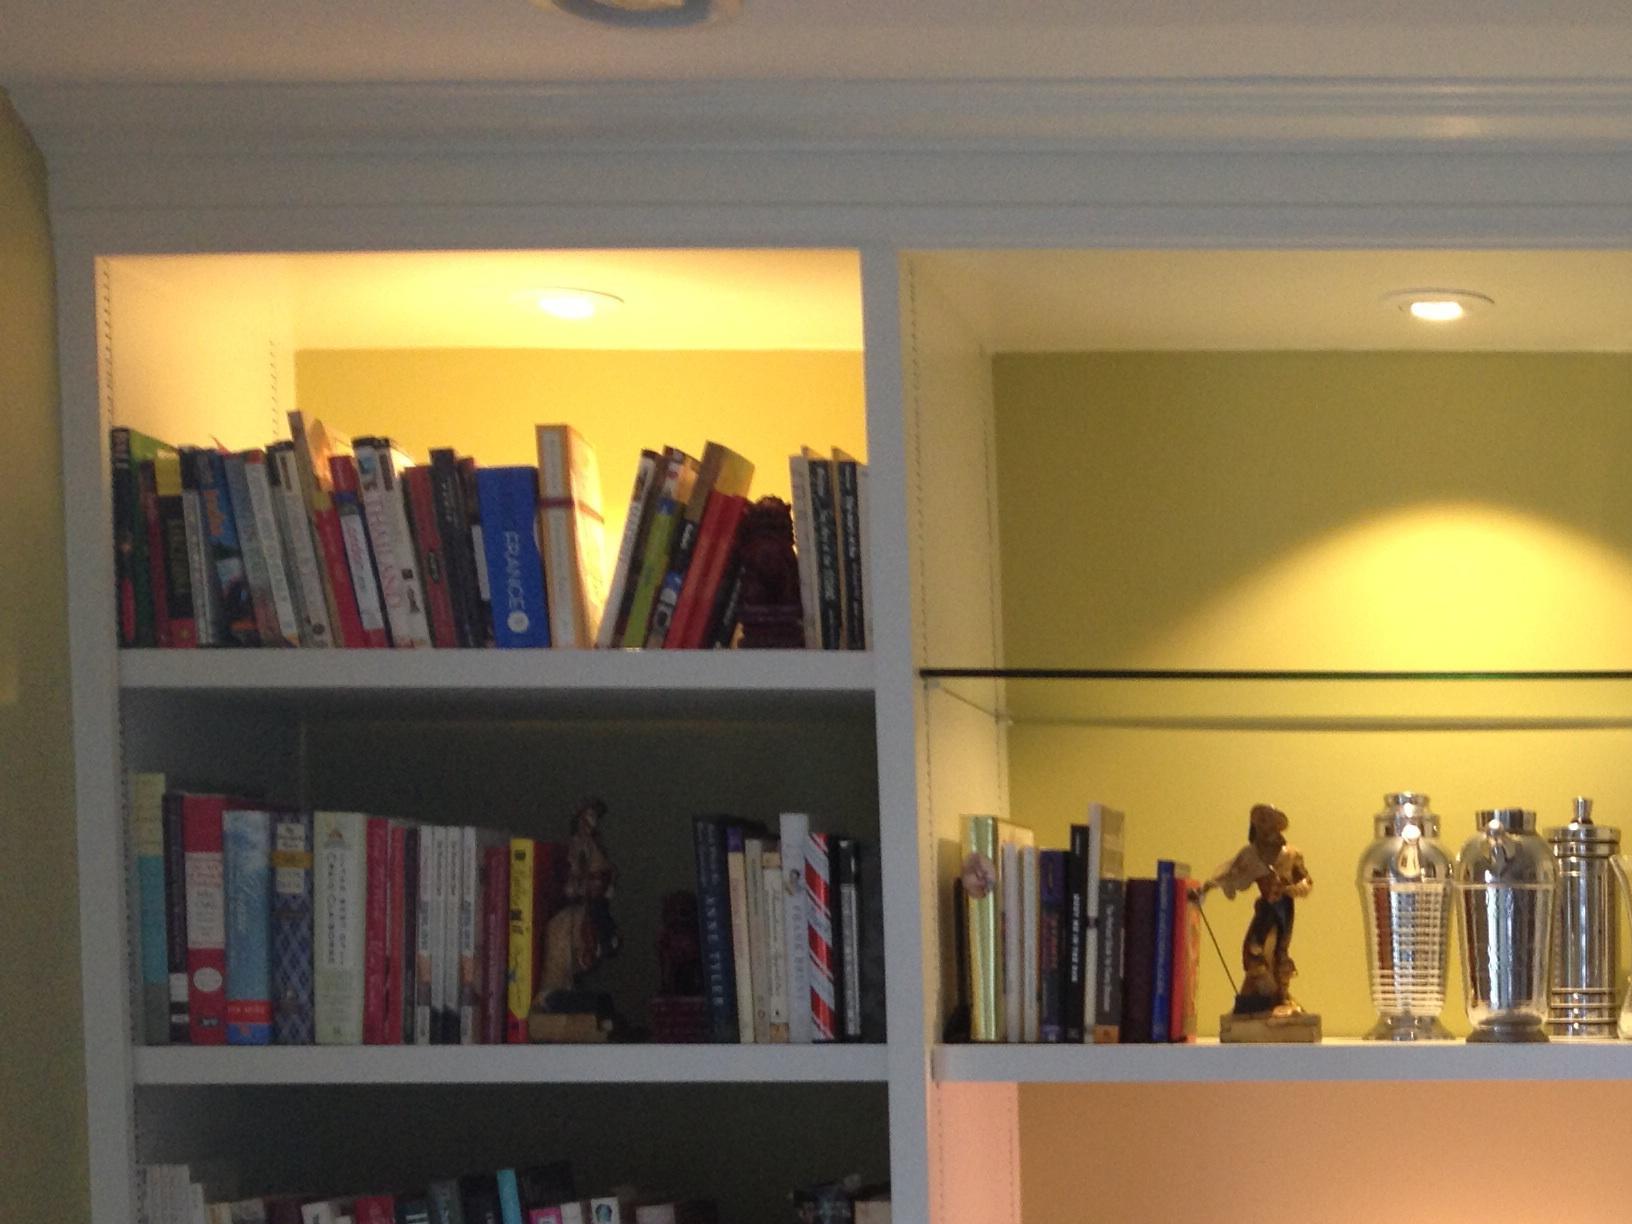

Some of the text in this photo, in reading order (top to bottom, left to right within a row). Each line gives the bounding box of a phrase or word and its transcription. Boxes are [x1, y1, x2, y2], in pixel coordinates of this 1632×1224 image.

[503, 531, 525, 610] FRANCE
[337, 897, 347, 928] BEST
[710, 952, 724, 1007] TYLER
